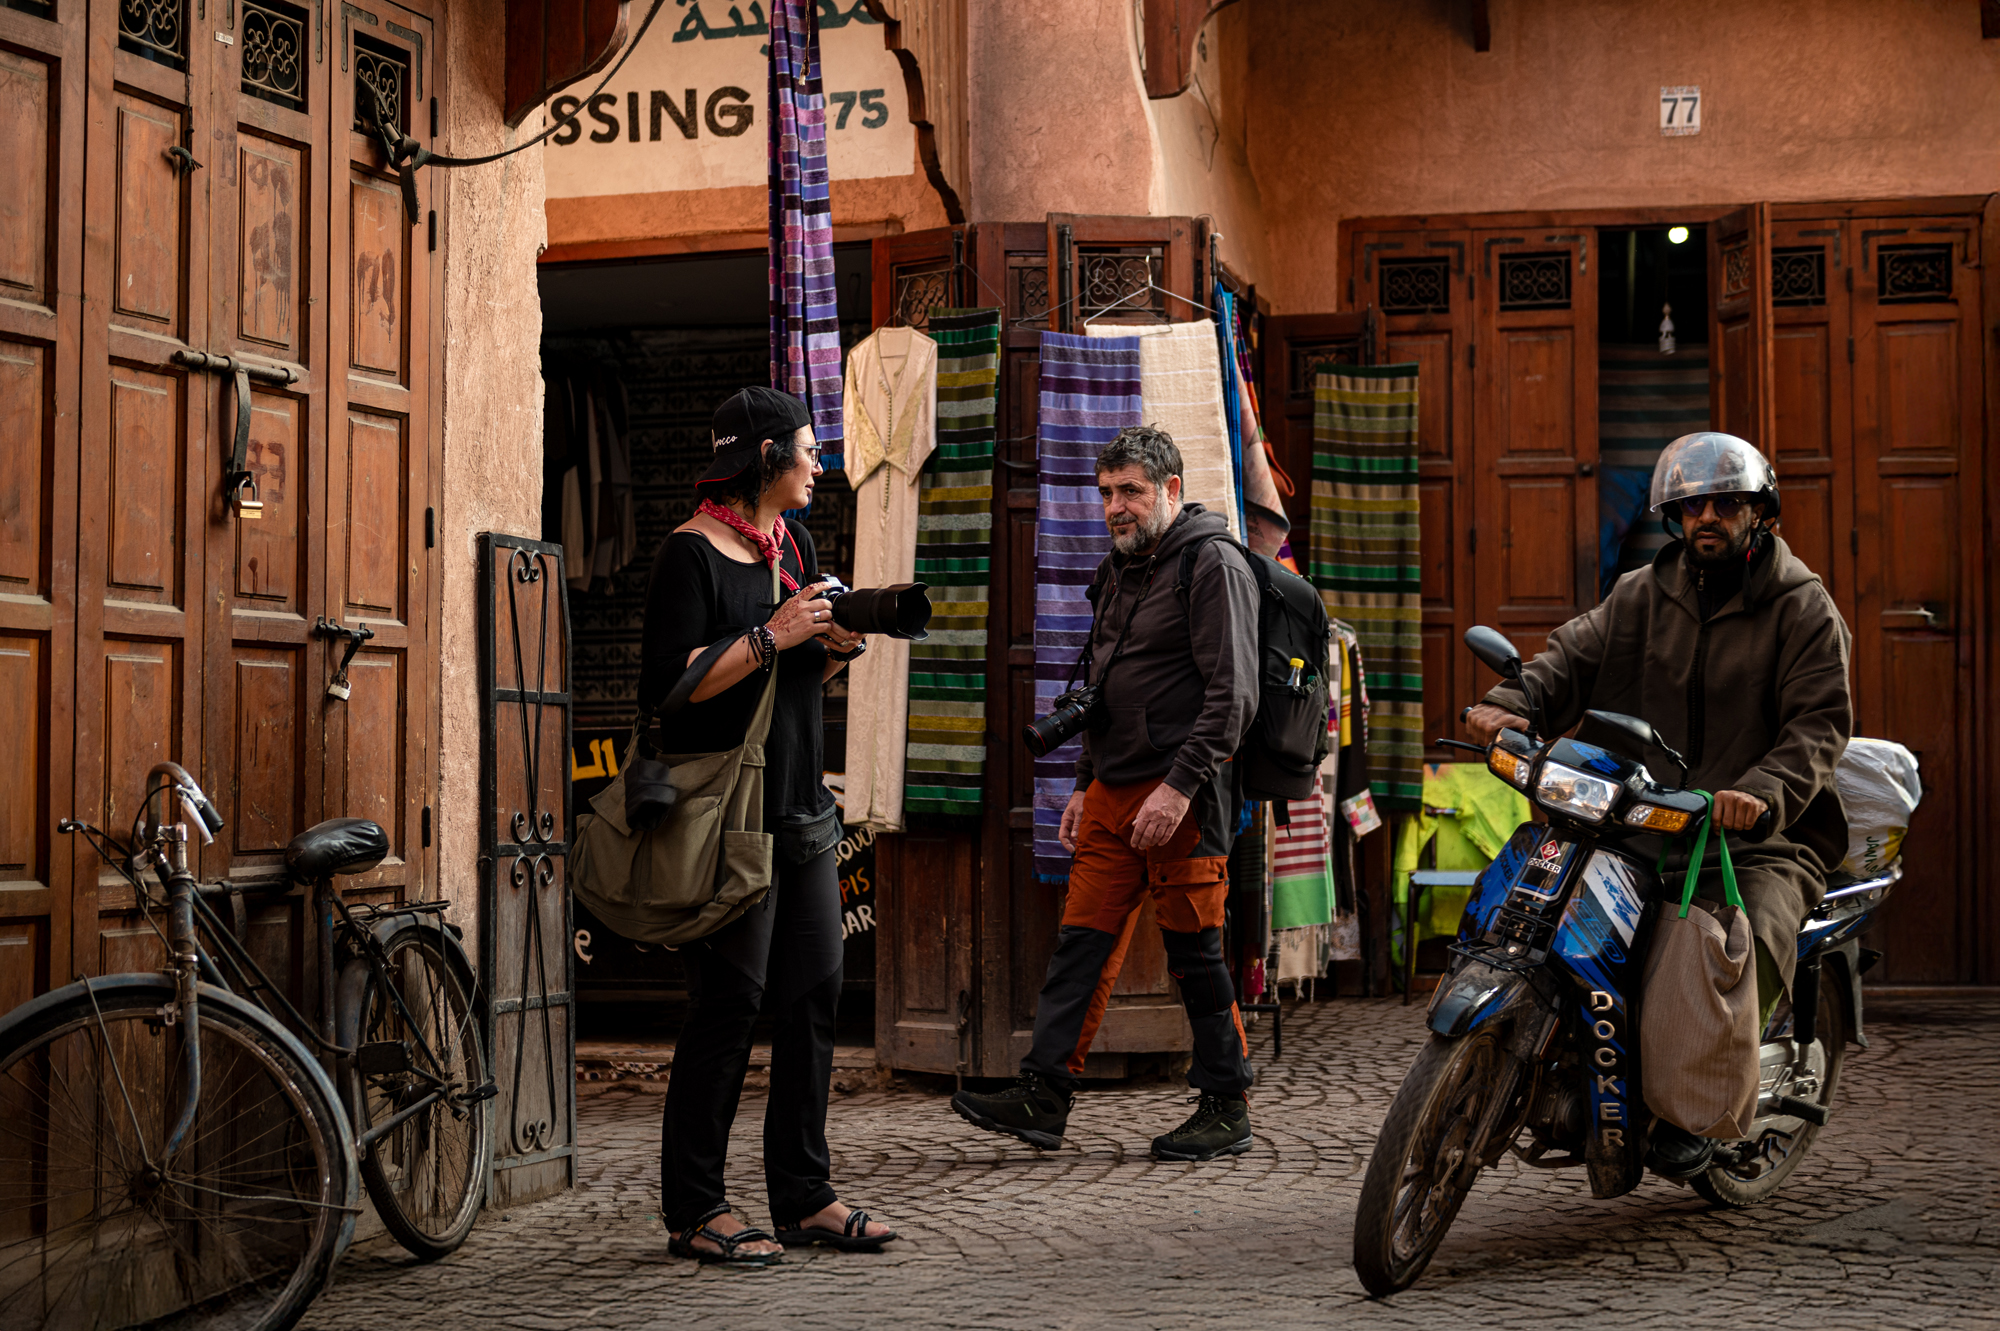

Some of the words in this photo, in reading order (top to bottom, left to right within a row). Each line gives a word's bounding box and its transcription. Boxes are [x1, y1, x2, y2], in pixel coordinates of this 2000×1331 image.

[544, 86, 754, 146] SSING
[822, 88, 889, 131] 75
[1662, 97, 1698, 124] 77
[840, 866, 871, 907] PIS
[1529, 858, 1560, 874] DOCKER
[1591, 990, 1625, 1147] DOCKER
